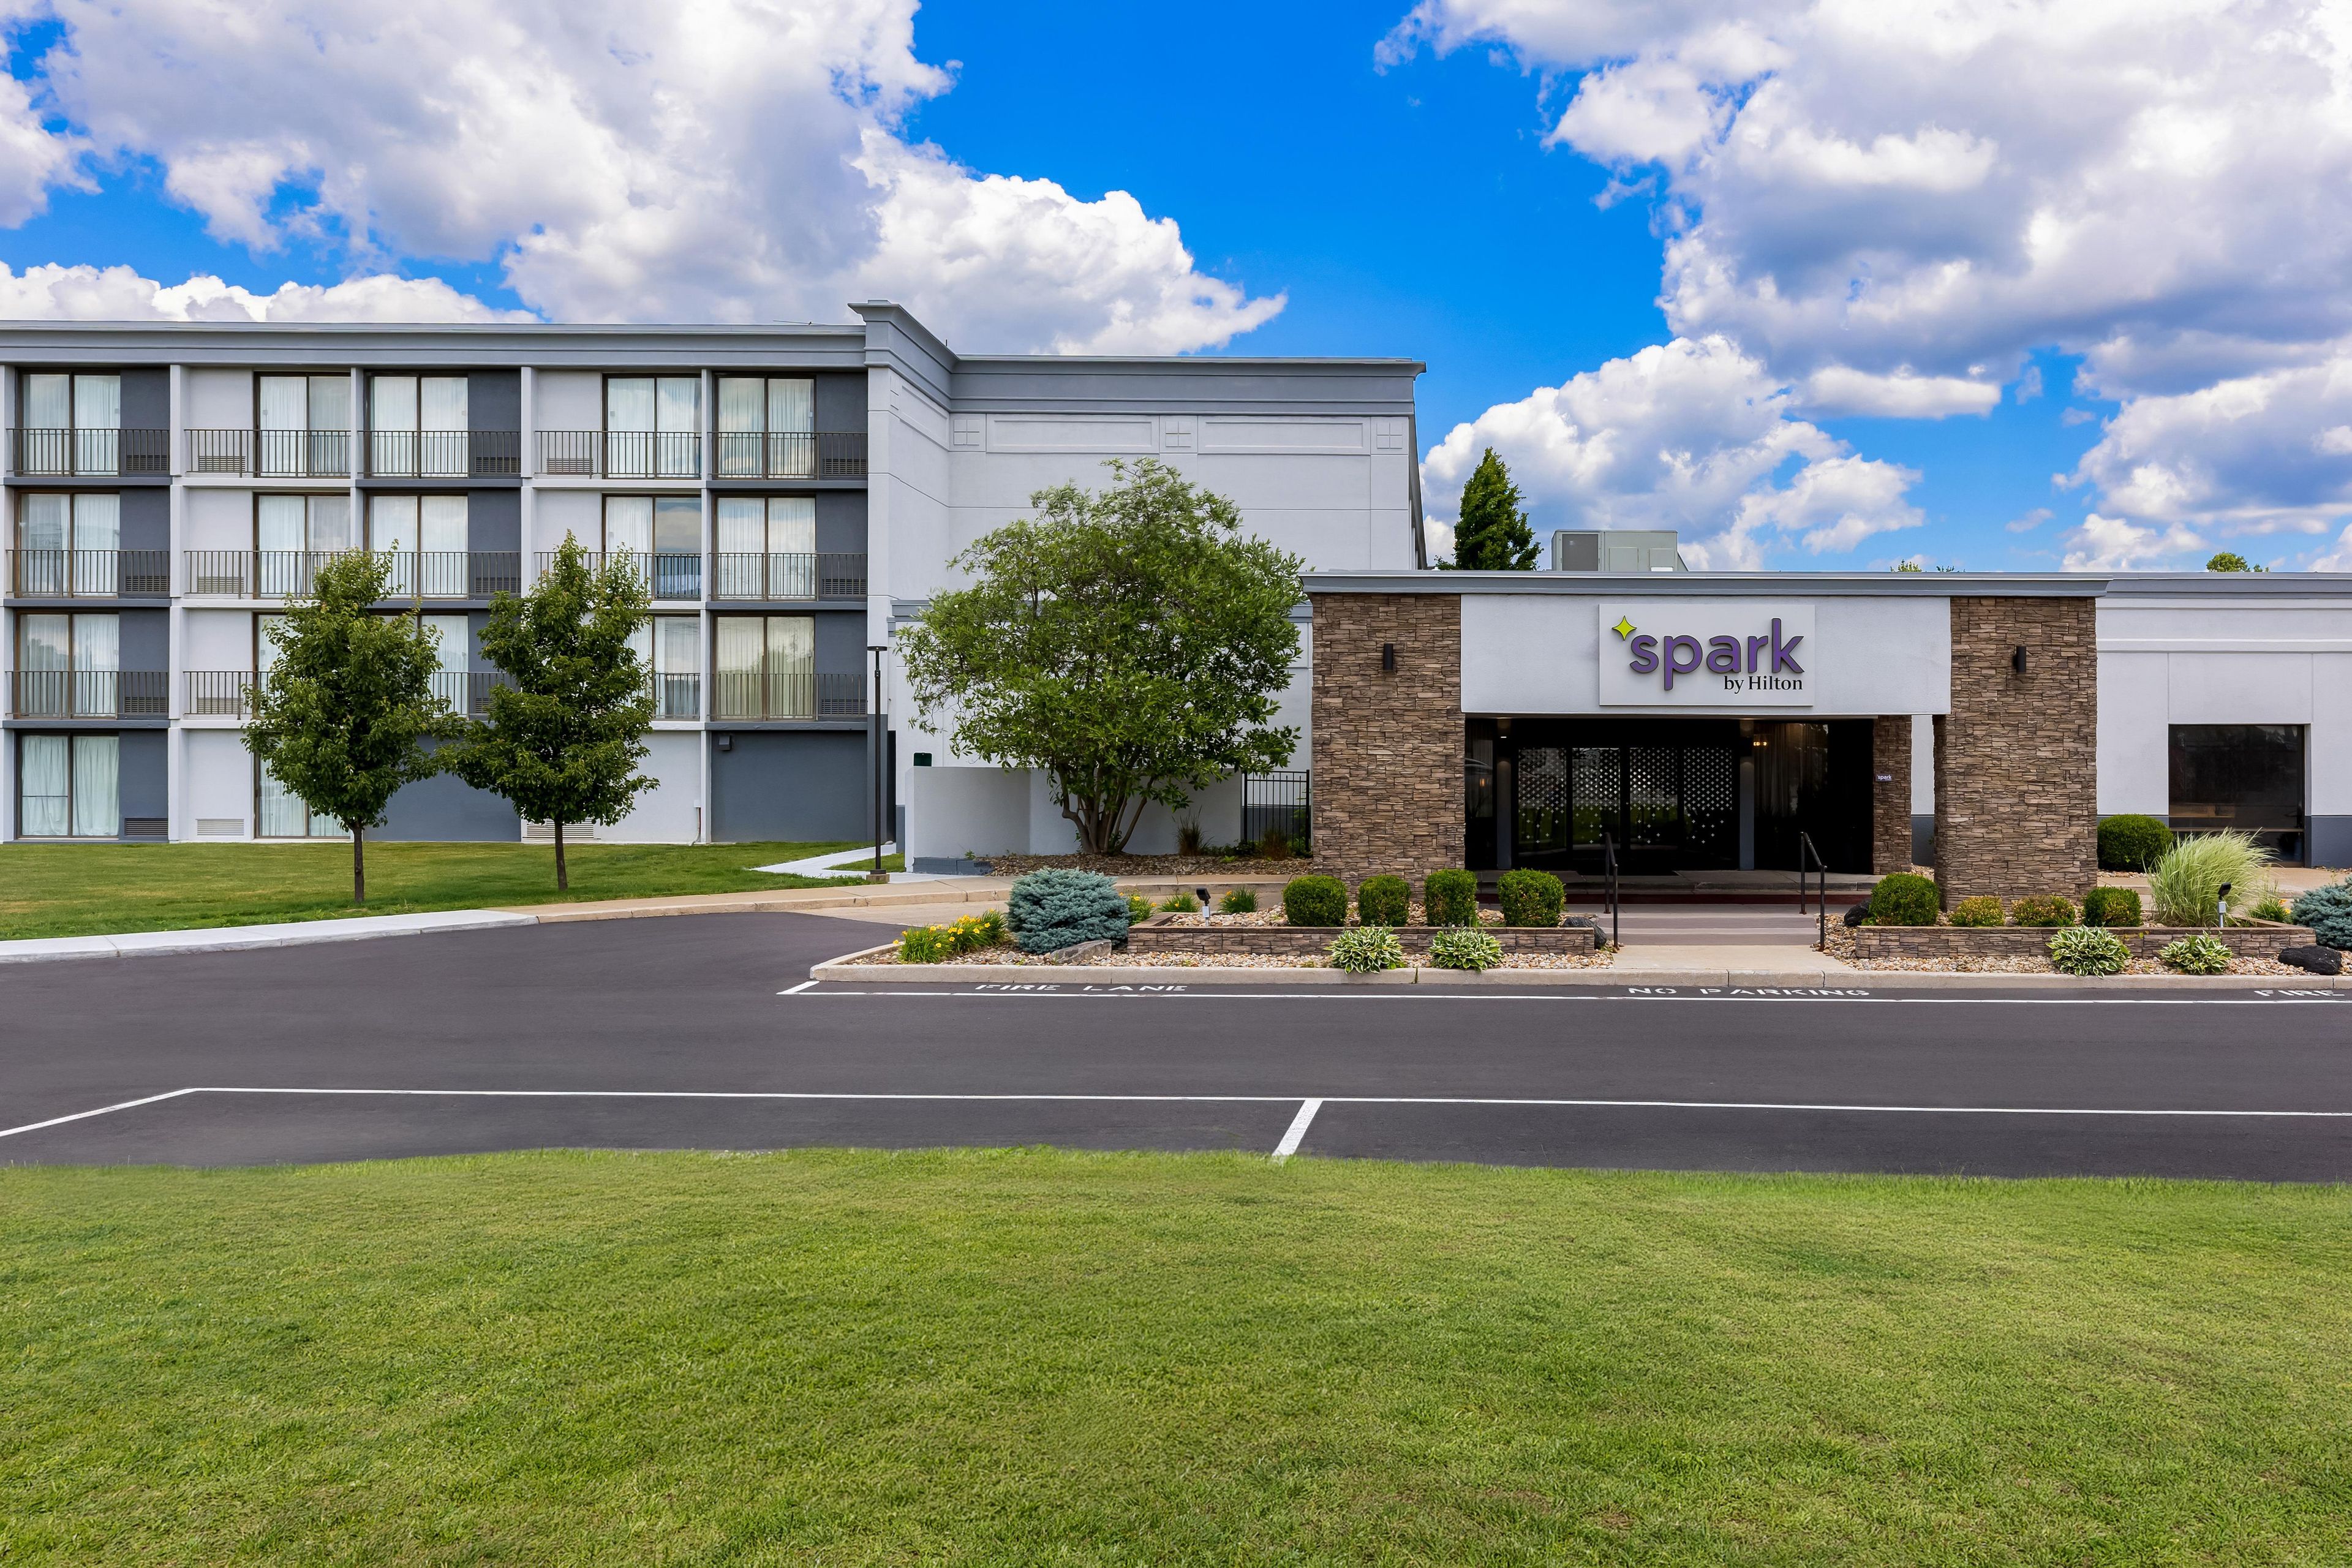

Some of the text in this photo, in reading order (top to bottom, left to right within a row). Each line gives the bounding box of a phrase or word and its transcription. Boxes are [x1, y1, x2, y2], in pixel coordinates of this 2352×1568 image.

[1630, 618, 1804, 690] spark
[1724, 676, 1803, 694] by Hilton
